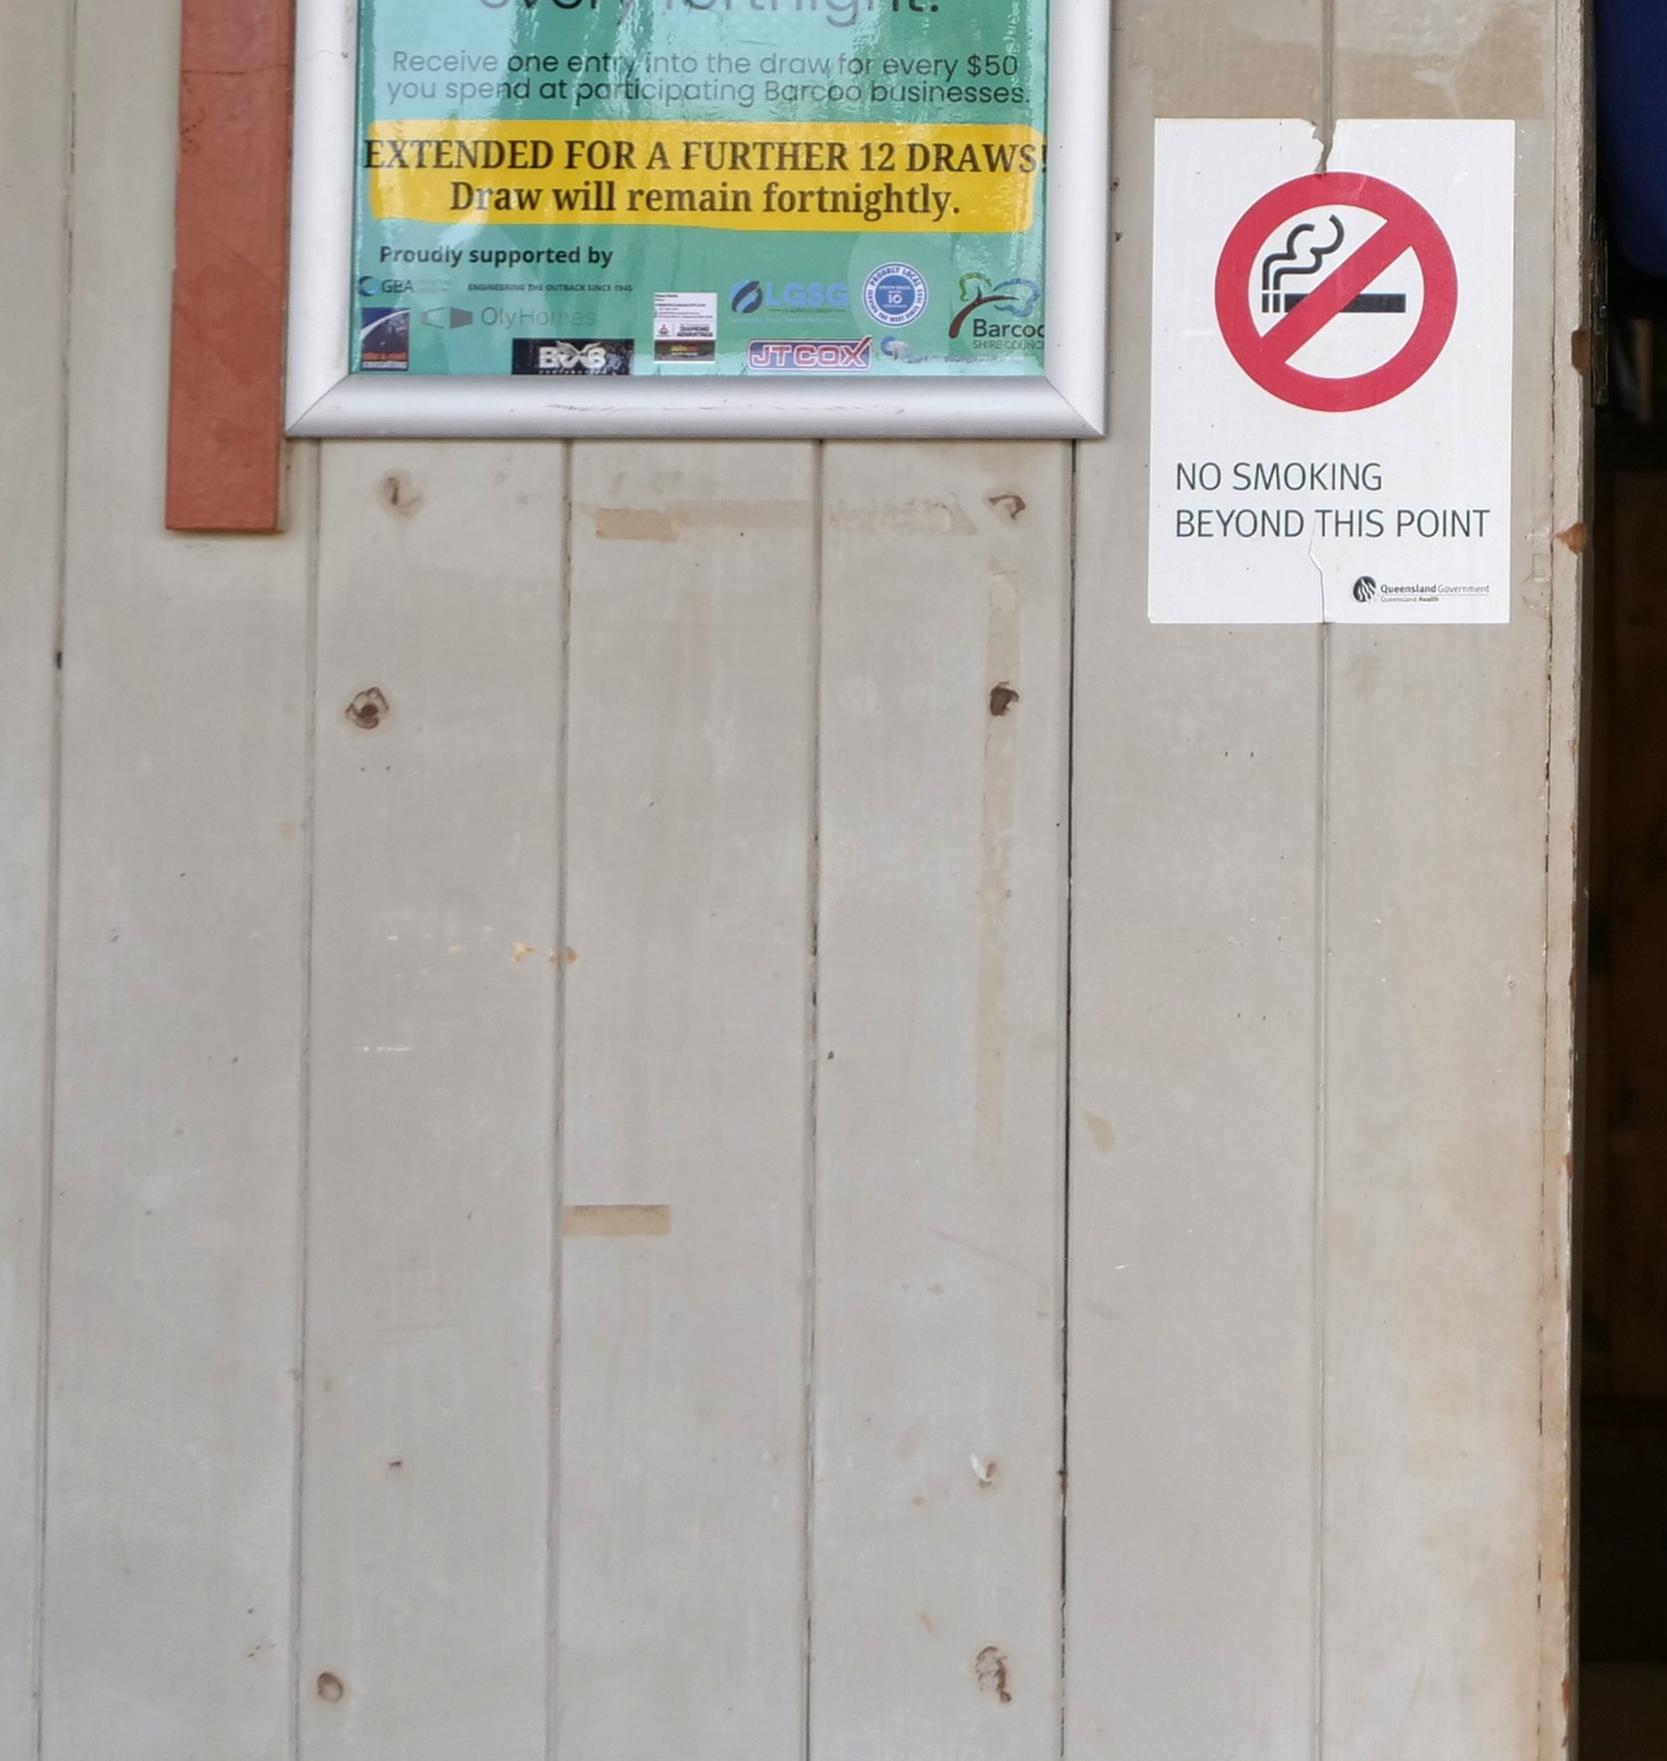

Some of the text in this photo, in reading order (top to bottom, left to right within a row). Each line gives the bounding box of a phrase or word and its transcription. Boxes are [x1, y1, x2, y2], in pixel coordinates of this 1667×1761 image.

[393, 50, 1018, 81] Receive one entry into the draw for every $50
[388, 78, 1030, 107] you spend at participating Barcoo businesses.
[365, 140, 1047, 173] EXTENDED FOR A FURTHER 12 DRAWS!
[450, 180, 960, 222] Draw will remain fortnightly.
[380, 245, 613, 268] Proudly supported by
[1004, 339, 1044, 350] COUNC
[1175, 462, 1383, 491] NO SMOKING
[1175, 508, 1491, 538] BEYOND THIS POINT
[1380, 583, 1490, 593] Queensland Government
